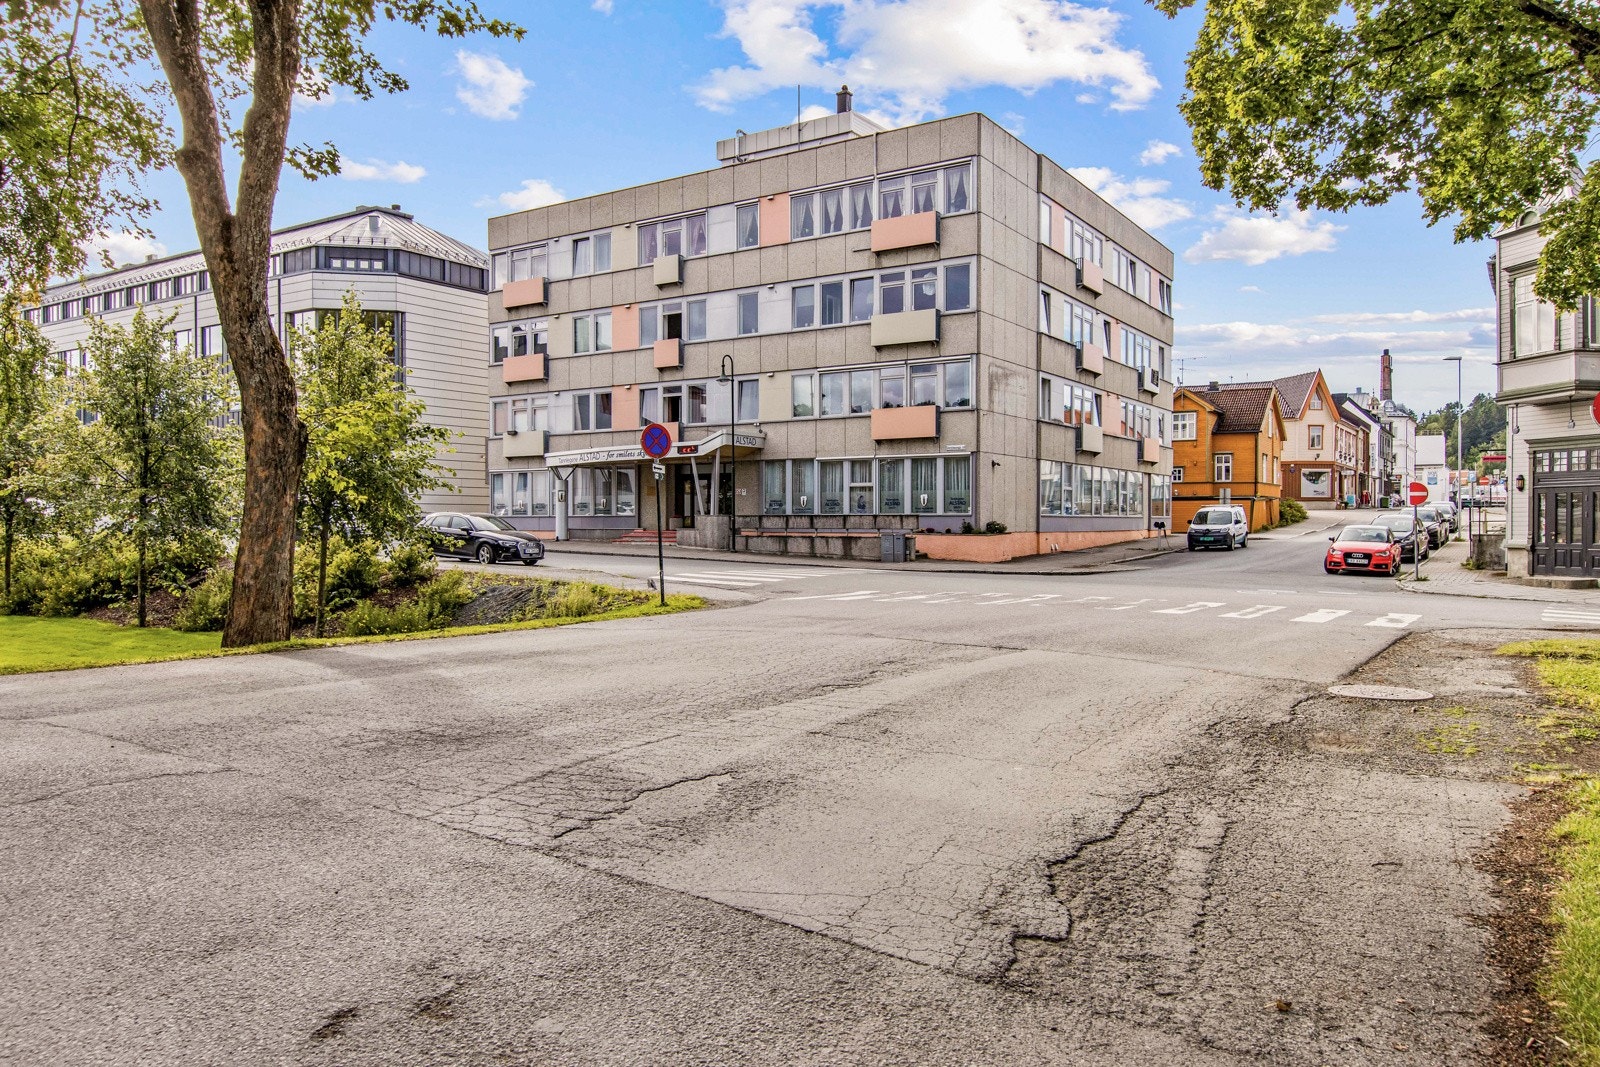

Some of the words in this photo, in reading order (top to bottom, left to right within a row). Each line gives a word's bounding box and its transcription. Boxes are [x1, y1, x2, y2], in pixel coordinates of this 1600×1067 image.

[736, 436, 757, 446] ALSTAD
[579, 452, 600, 462] ALSTAD
[605, 450, 615, 461] for
